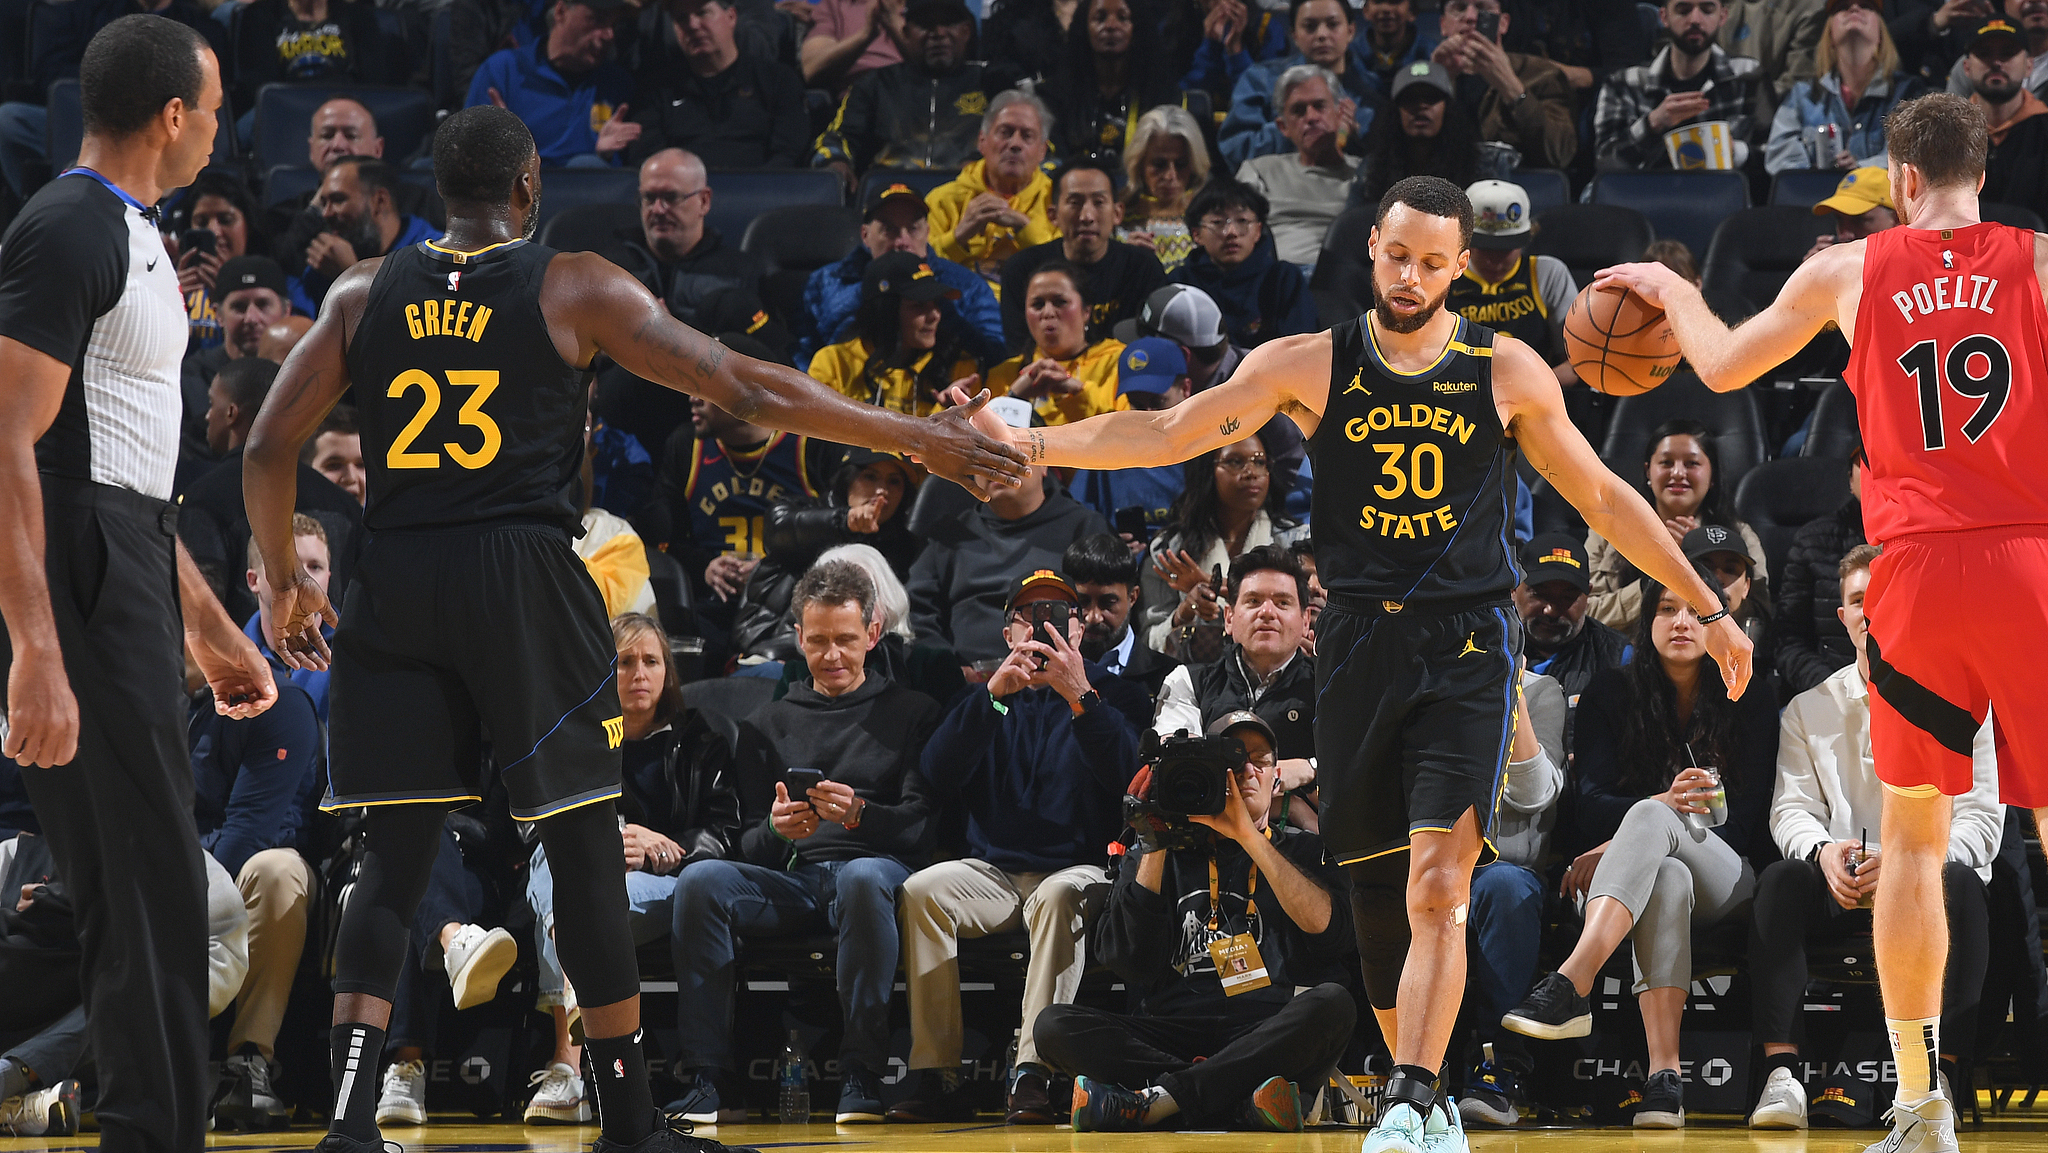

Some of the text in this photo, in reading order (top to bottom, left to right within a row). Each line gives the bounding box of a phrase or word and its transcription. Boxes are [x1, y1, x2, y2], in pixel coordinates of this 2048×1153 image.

[1460, 295, 1535, 323] FRANCISCO
[1892, 275, 1998, 324] POELTL
[405, 300, 493, 343] GREEN
[1432, 381, 1477, 392] Rakuten
[1896, 334, 2012, 451] 19
[386, 368, 502, 470] 23
[1345, 404, 1476, 444] GOLDEN
[1372, 443, 1443, 500] 30
[699, 477, 786, 516] GOLDE
[1360, 504, 1457, 539] STATE
[1219, 944, 1245, 956] MEDIA
[1574, 1059, 1695, 1083] CHAE
[1798, 1060, 1898, 1083] HASE
